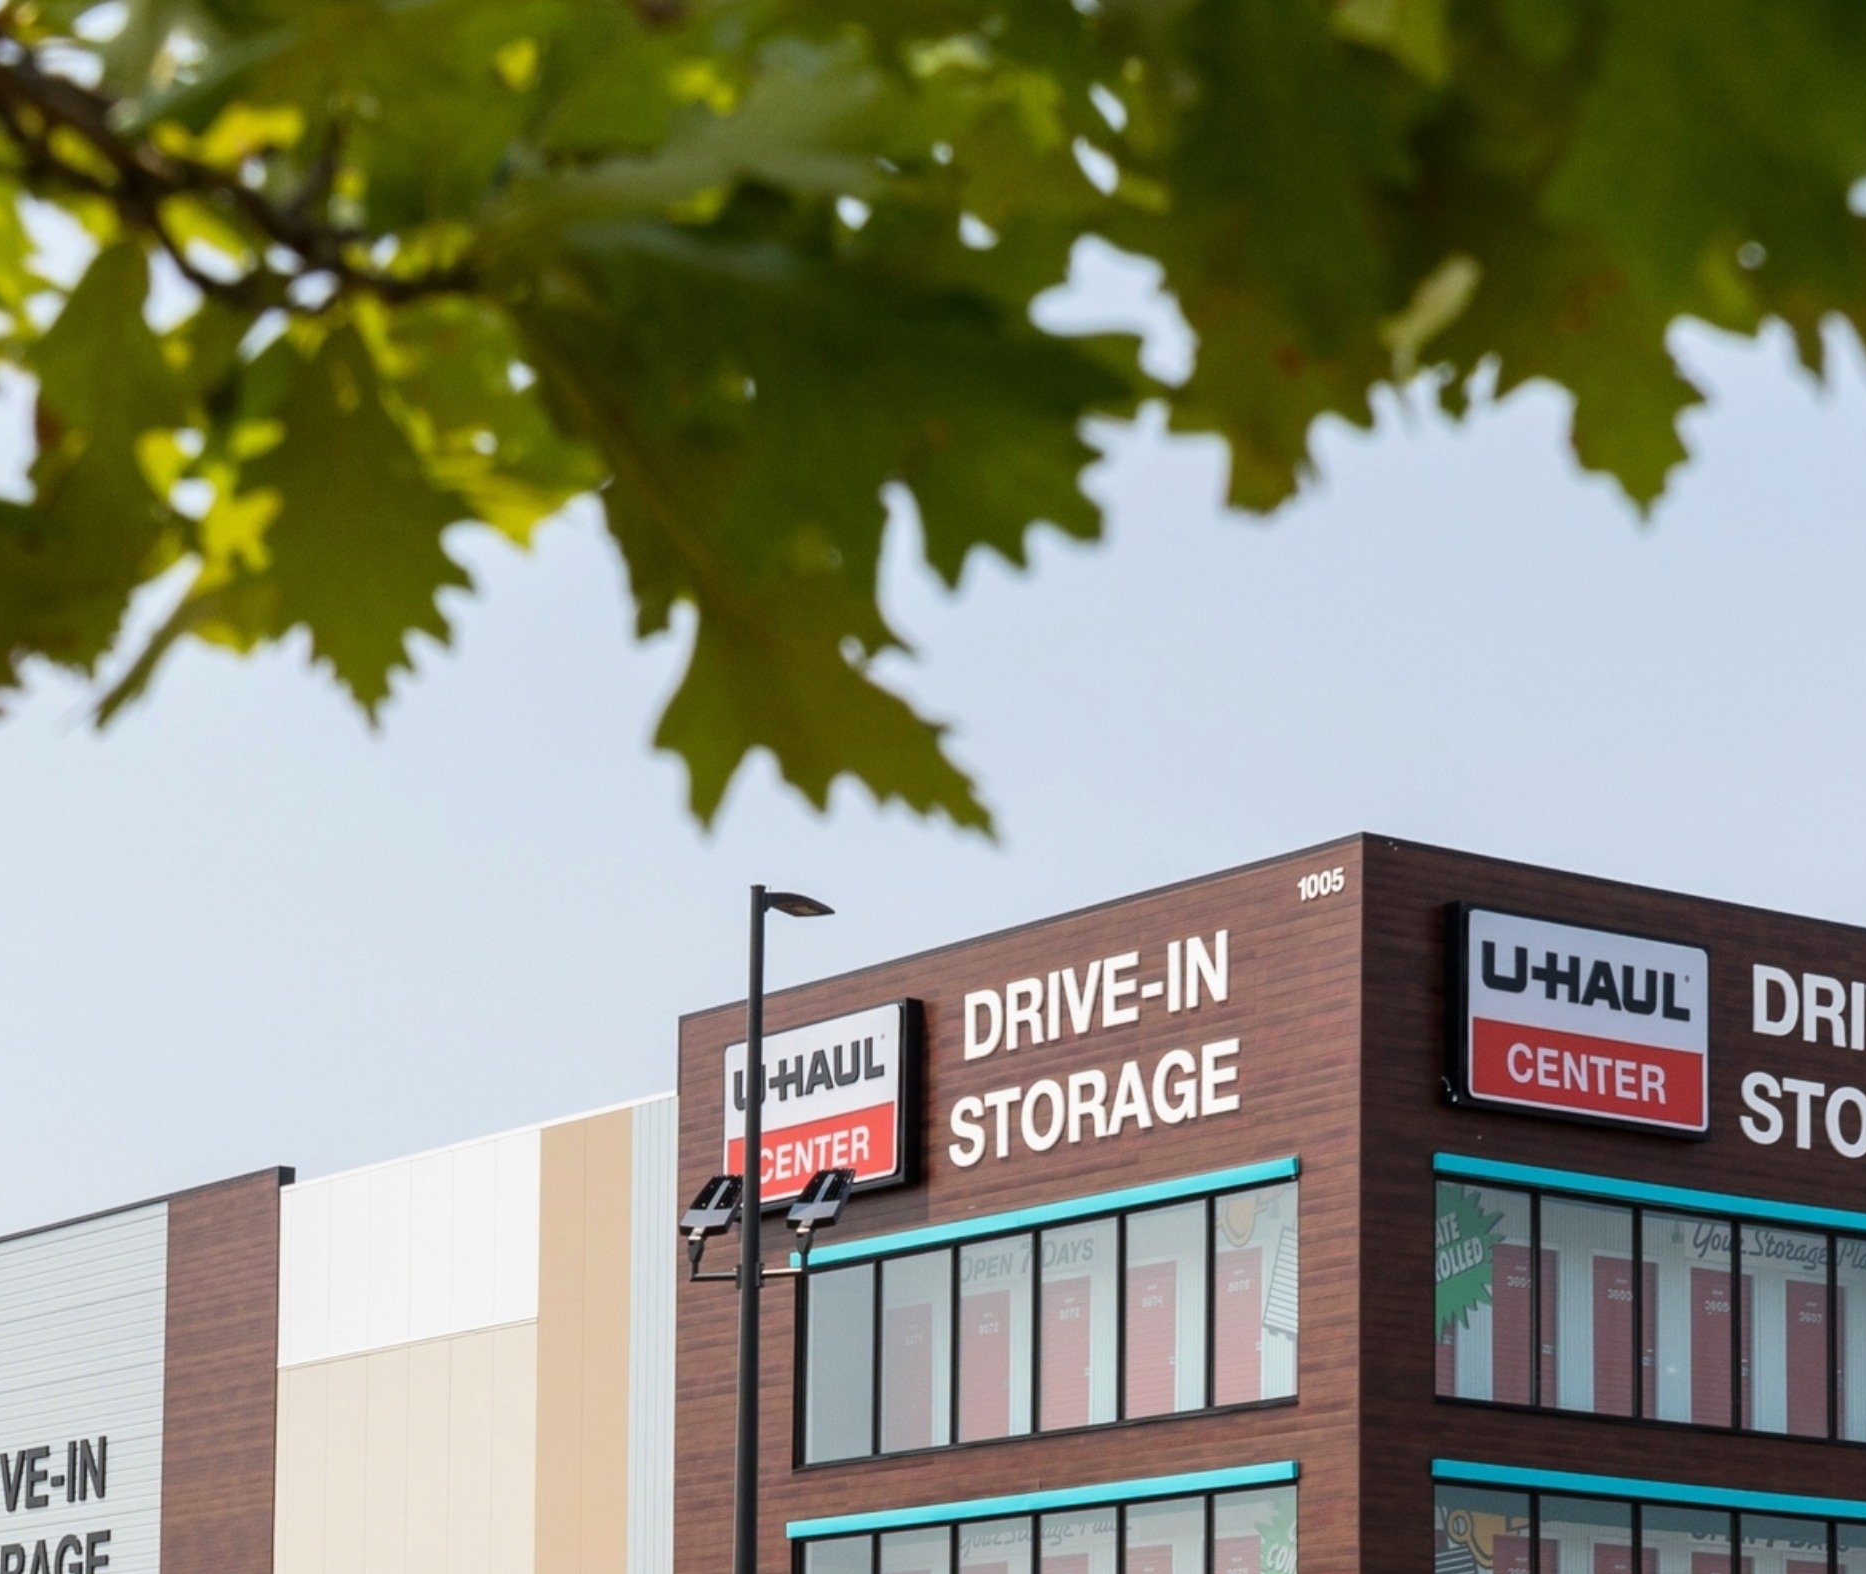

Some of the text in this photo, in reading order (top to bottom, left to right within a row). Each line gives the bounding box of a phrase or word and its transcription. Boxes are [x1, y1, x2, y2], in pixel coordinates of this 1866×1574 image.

[1297, 866, 1345, 901] 1005
[964, 929, 1229, 1061] DRIVE-IN
[1482, 940, 1691, 1022] U-HAUL
[949, 1038, 1240, 1167] STORAGE
[1507, 1042, 1666, 1104] CENTER
[760, 1125, 870, 1184] CENTER
